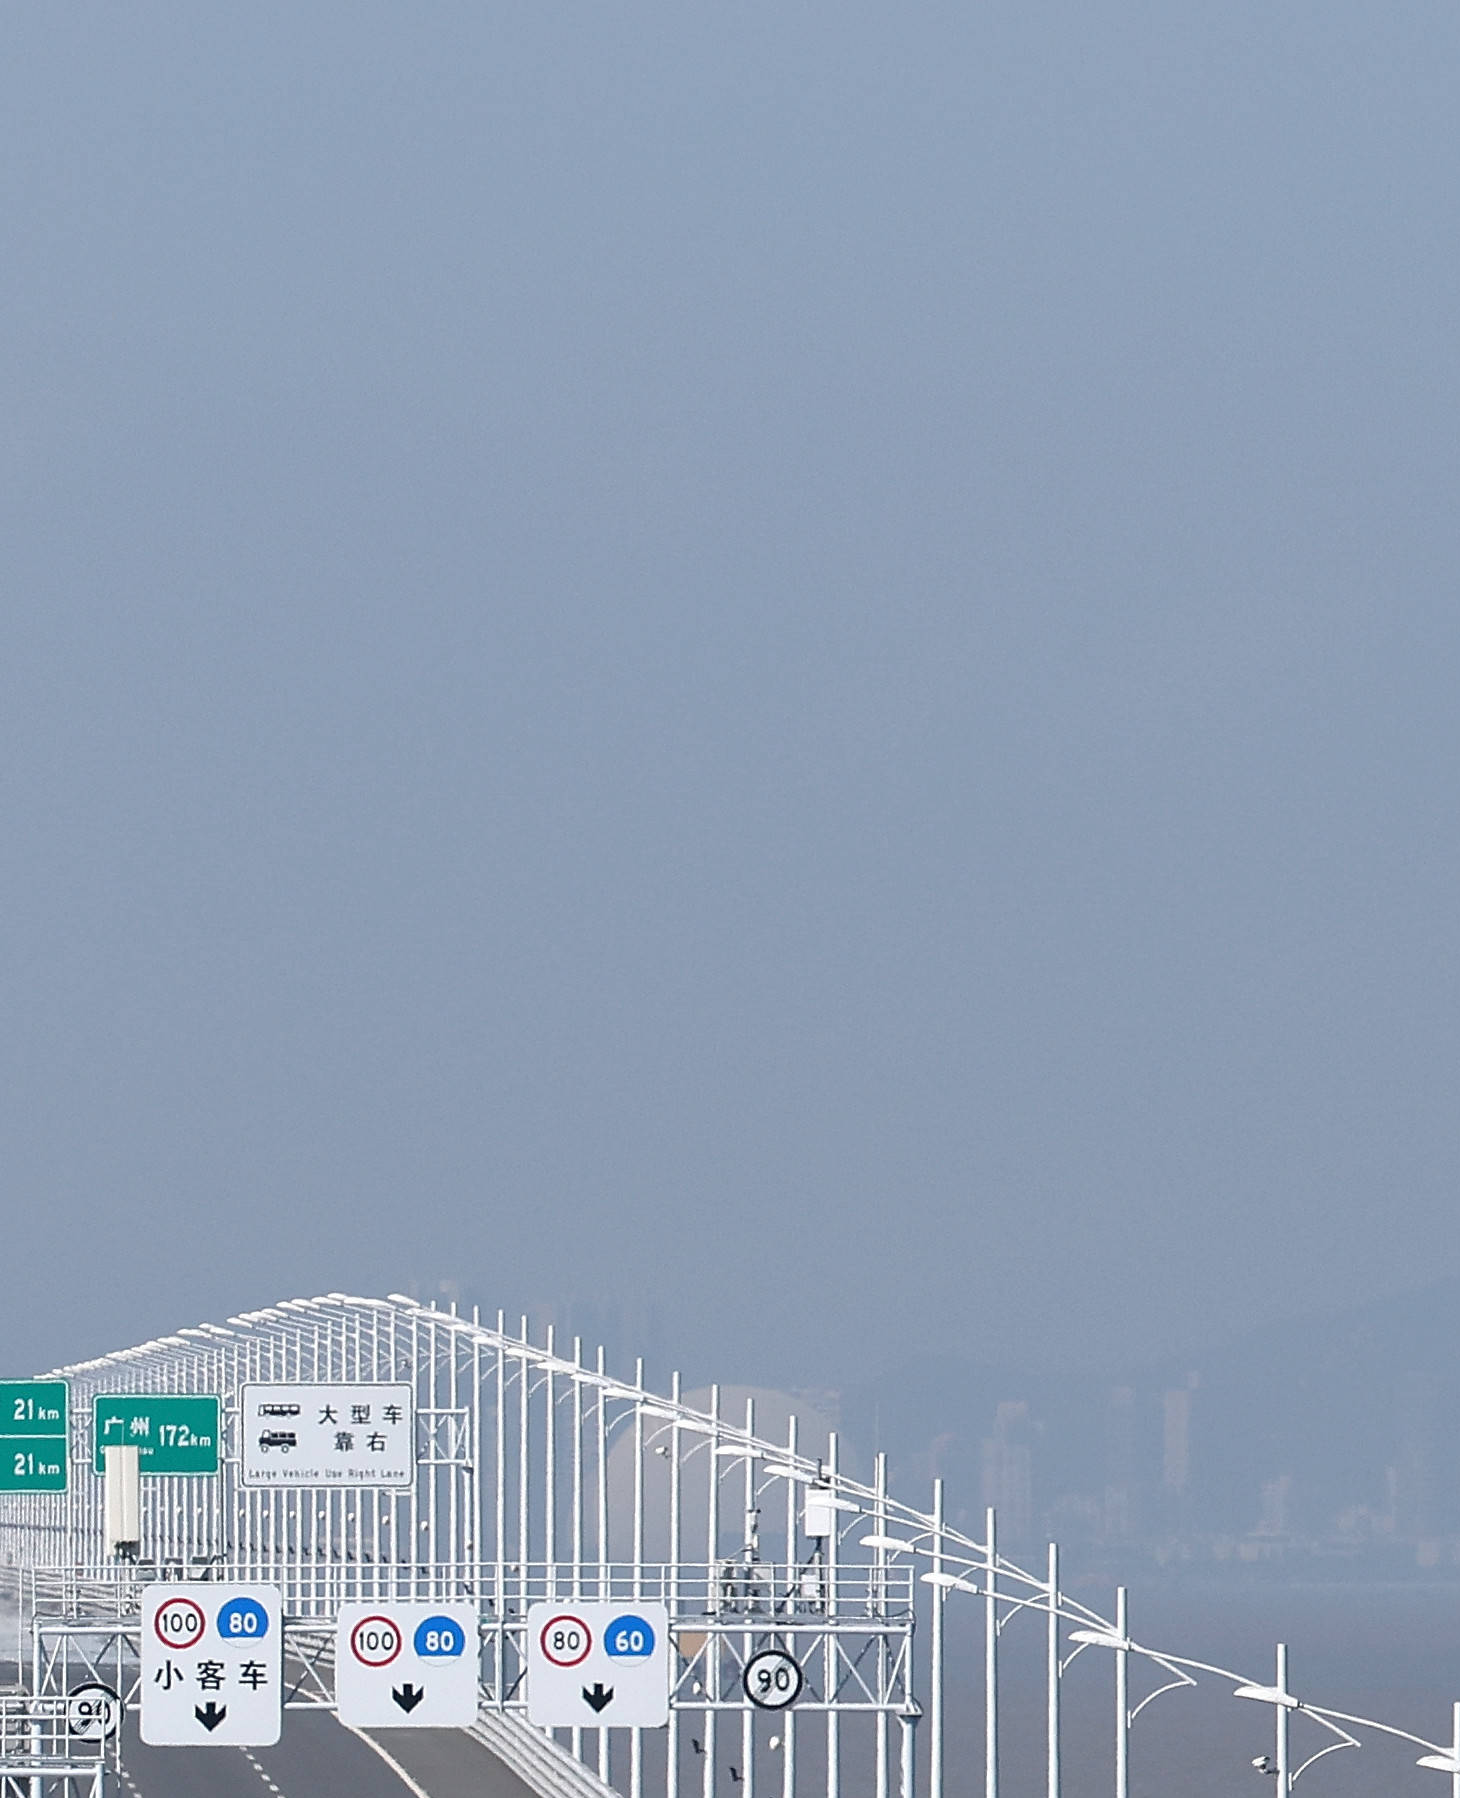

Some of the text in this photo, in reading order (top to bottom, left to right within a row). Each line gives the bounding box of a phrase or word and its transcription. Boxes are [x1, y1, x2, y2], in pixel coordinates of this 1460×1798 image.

[13, 1398, 33, 1420] 21
[38, 1407, 59, 1420] km
[317, 1404, 403, 1425] 大型车
[103, 1416, 211, 1447] 广州 172 km
[334, 1431, 387, 1452] 靠右
[14, 1453, 34, 1475] 21
[38, 1462, 60, 1475] km
[248, 1469, 406, 1481] Large Vehicle Use Right Lane
[162, 1613, 198, 1633] 100
[229, 1612, 258, 1634] 80
[359, 1631, 394, 1651] 100
[425, 1630, 454, 1652] 80
[553, 1631, 580, 1650] 80
[615, 1630, 644, 1652] 60
[154, 1660, 268, 1691] 小客车
[757, 1667, 790, 1693] 90
